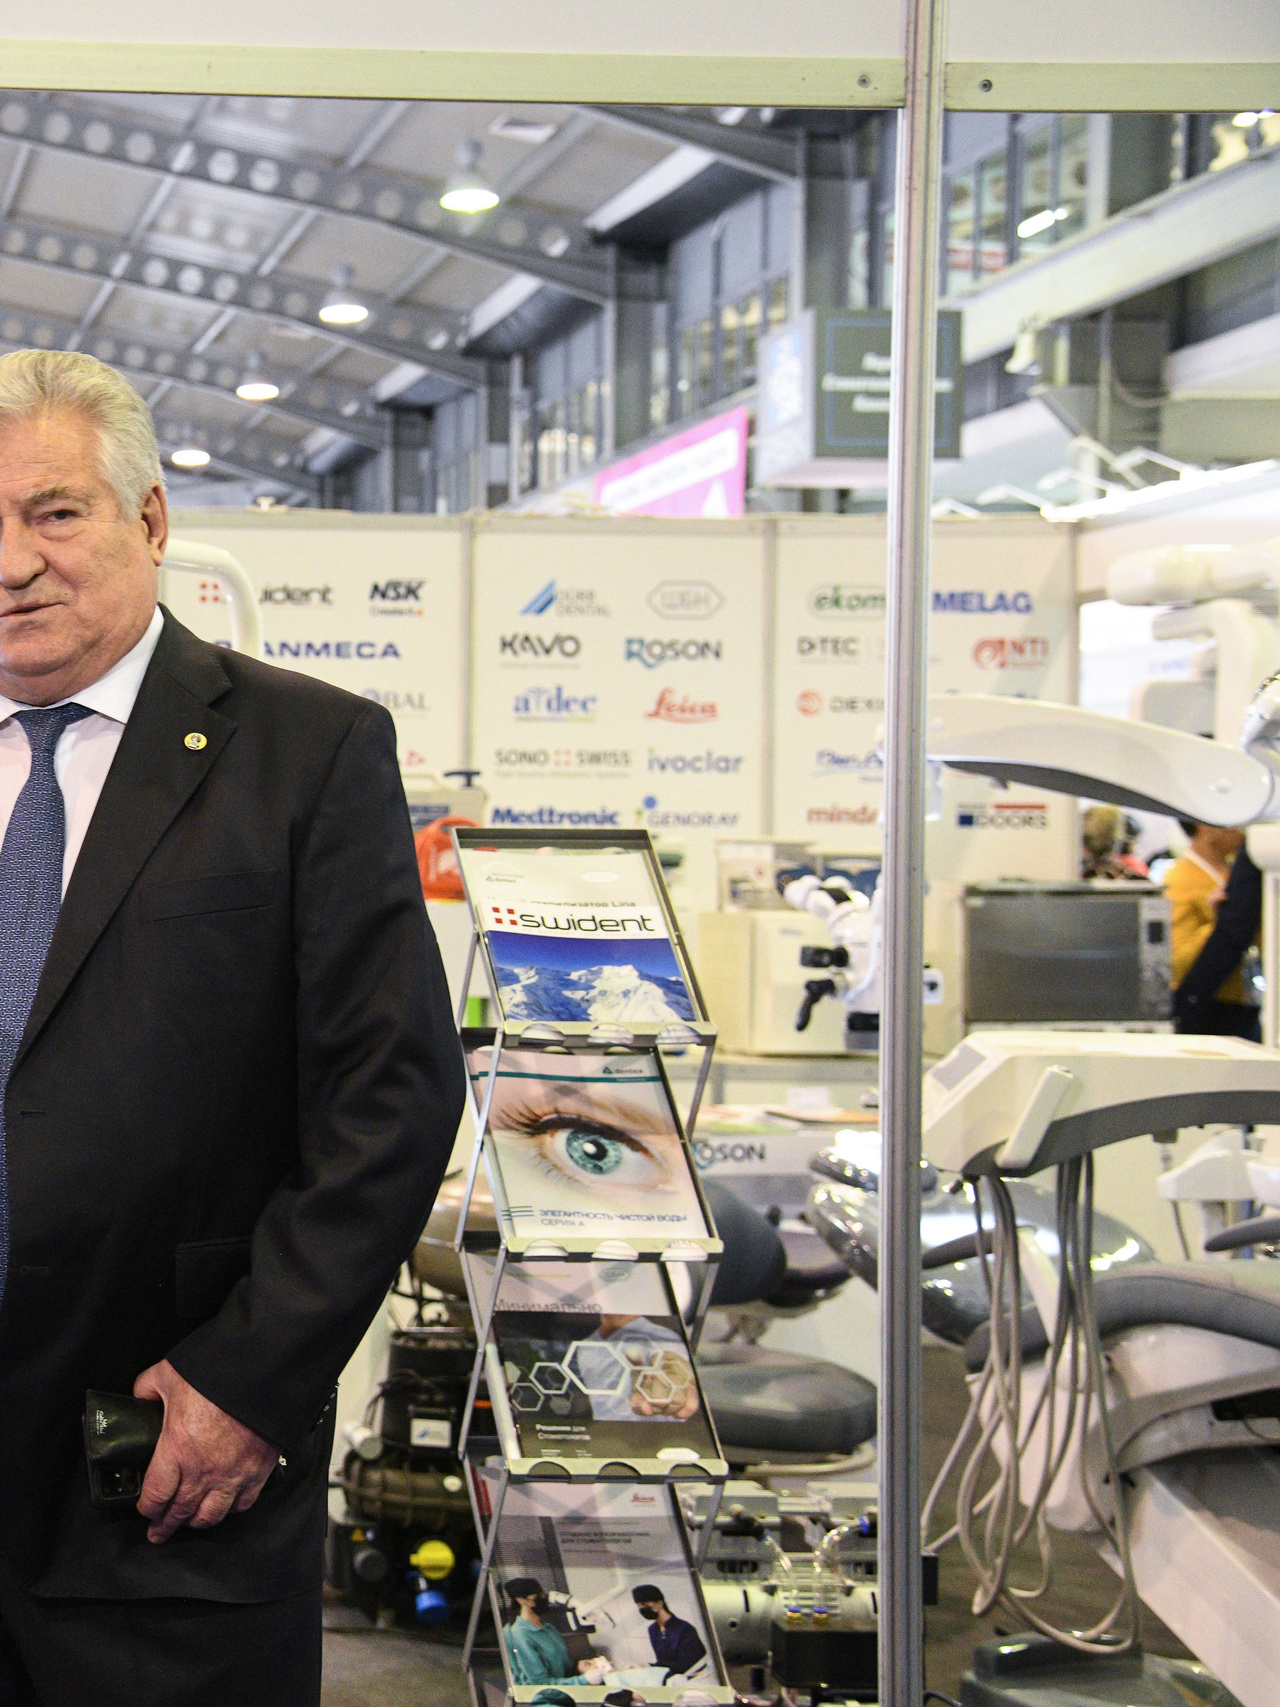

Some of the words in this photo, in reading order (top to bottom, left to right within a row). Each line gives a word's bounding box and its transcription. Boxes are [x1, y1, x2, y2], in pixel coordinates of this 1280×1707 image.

[370, 579, 424, 600] NSK
[932, 591, 1033, 613] MELAG
[625, 637, 723, 668] ROSON
[648, 748, 744, 773] ivoclar
[491, 806, 618, 825] Medtronic
[519, 913, 656, 932] swident
[692, 1139, 766, 1170] OSON
